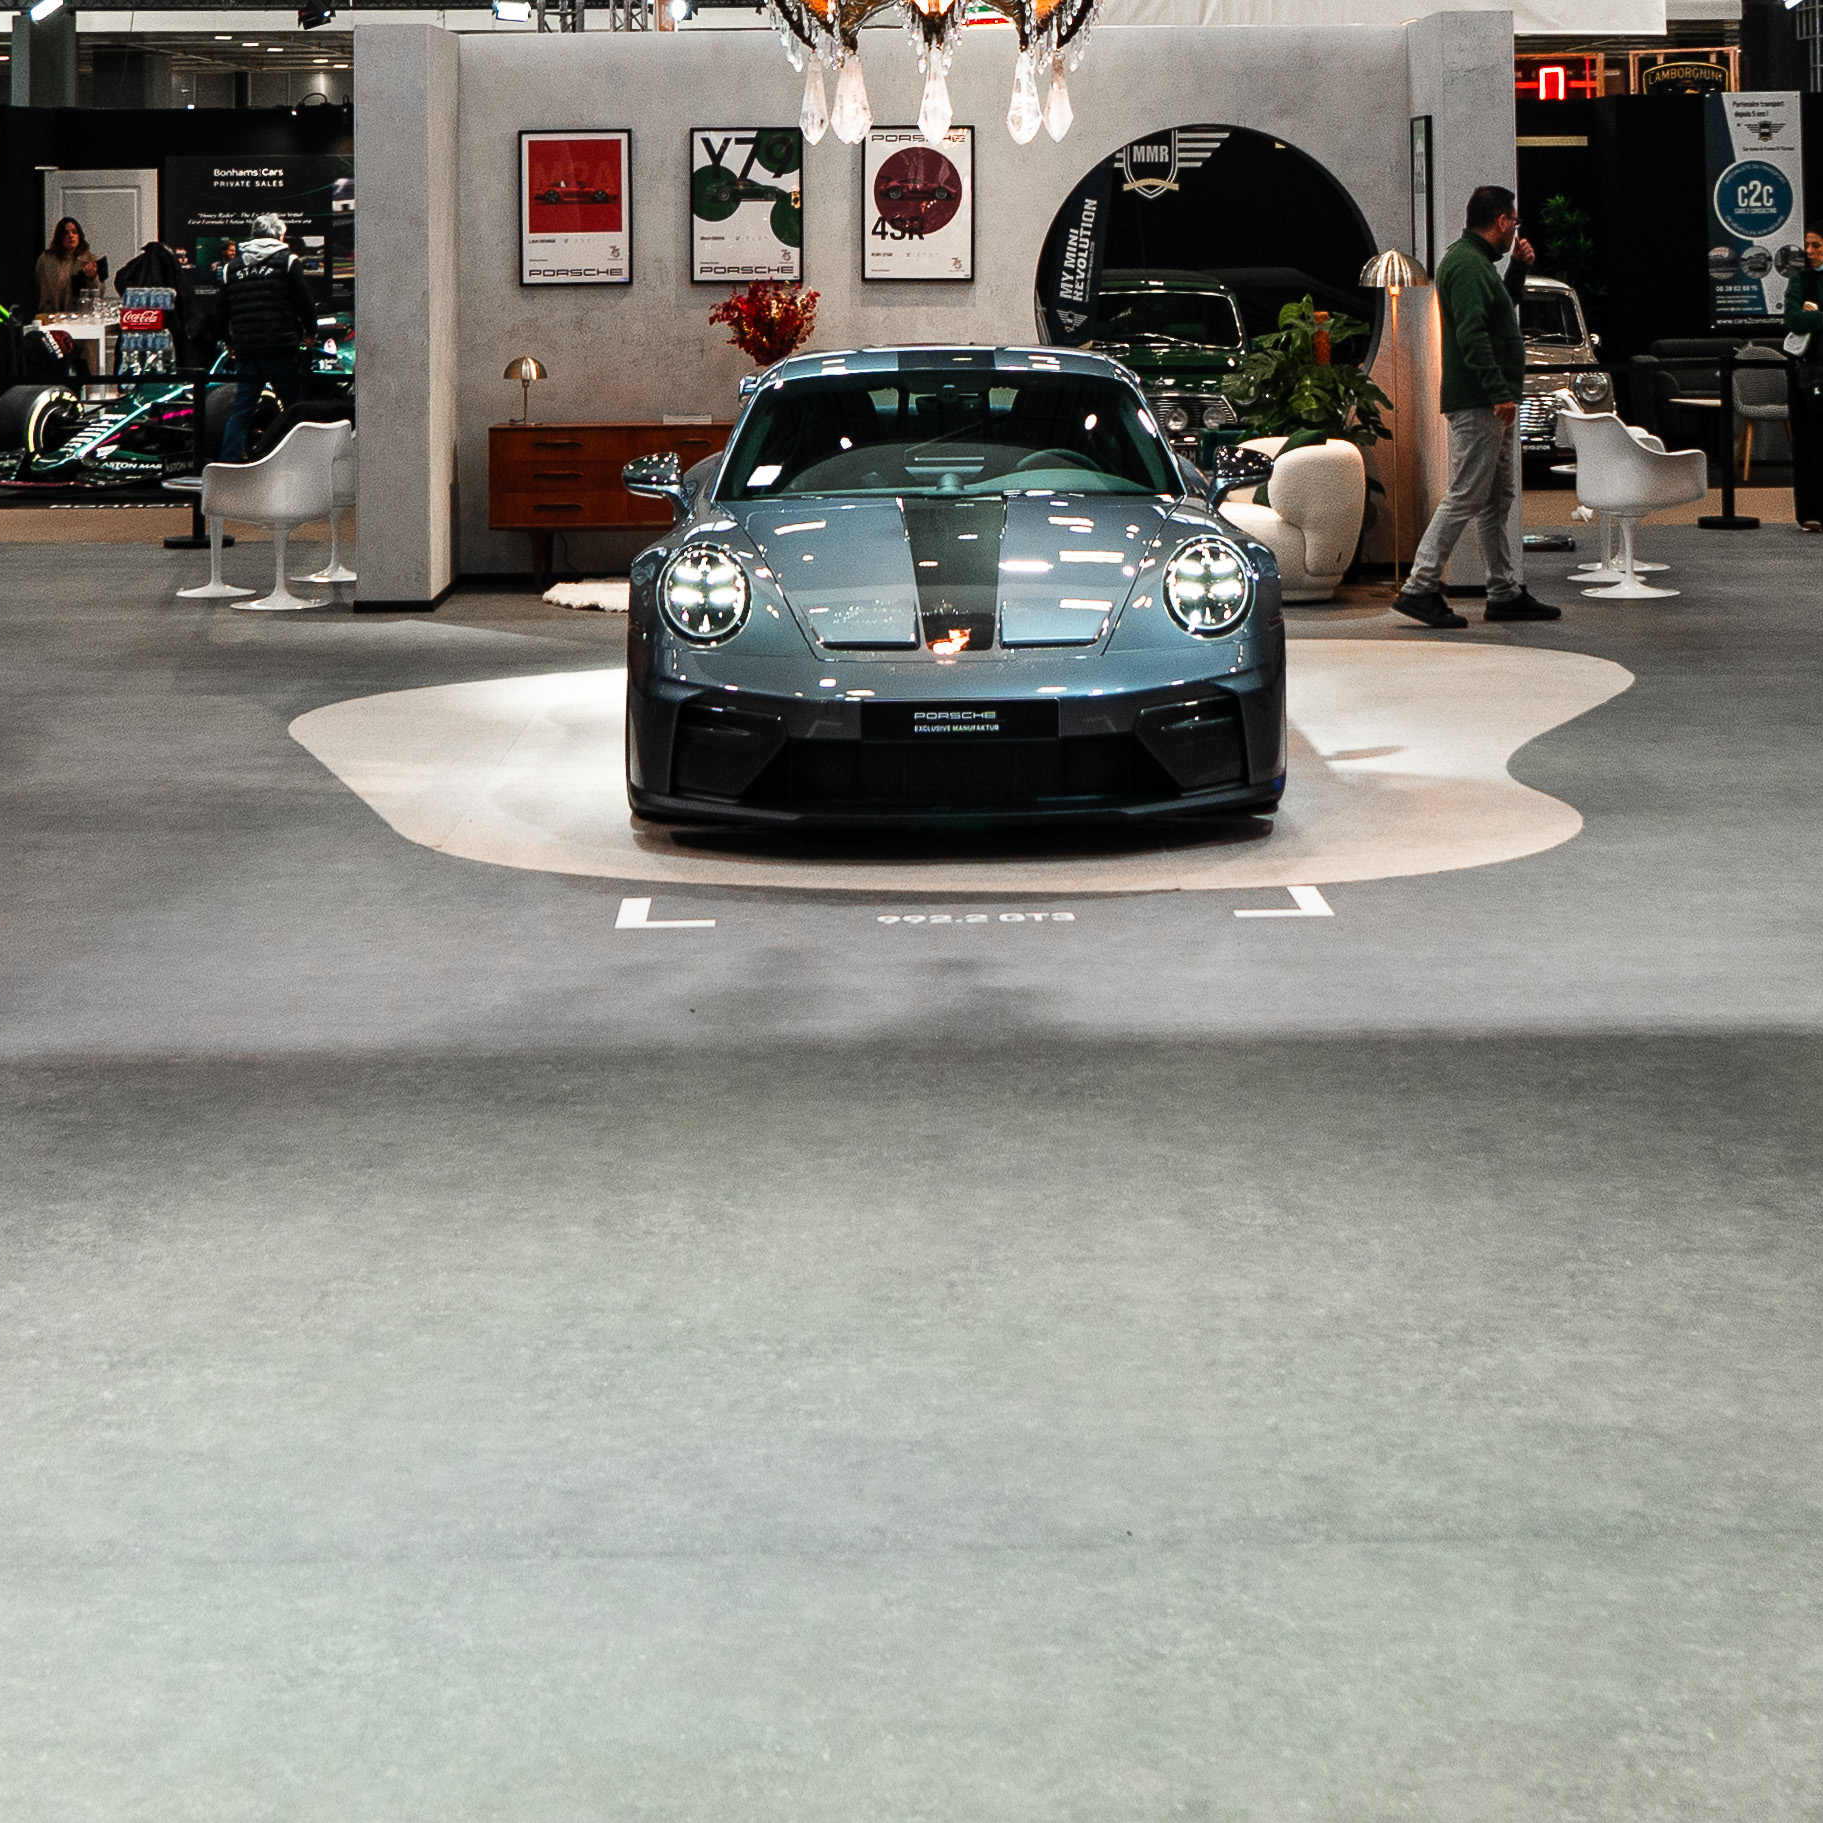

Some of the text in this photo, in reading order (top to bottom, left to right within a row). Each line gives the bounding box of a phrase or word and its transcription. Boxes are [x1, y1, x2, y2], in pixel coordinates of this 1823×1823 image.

[700, 137, 794, 179] Y79
[1132, 145, 1169, 163] MMR
[213, 168, 284, 177] Bonhams Cars
[255, 179, 284, 187] SALES
[1737, 180, 1774, 207] c2c
[1071, 198, 1098, 302] REVOLUTION
[1060, 228, 1079, 299] MY MINI
[236, 265, 275, 280] STAFF
[528, 268, 623, 277] PORSCHE
[699, 266, 794, 275] PORSCHE
[102, 461, 138, 470] ASTON
[914, 710, 997, 720] PORSCHE
[914, 724, 1000, 733] EXCLUSIVE MANUFAKTUR
[876, 913, 989, 924] 992.2
